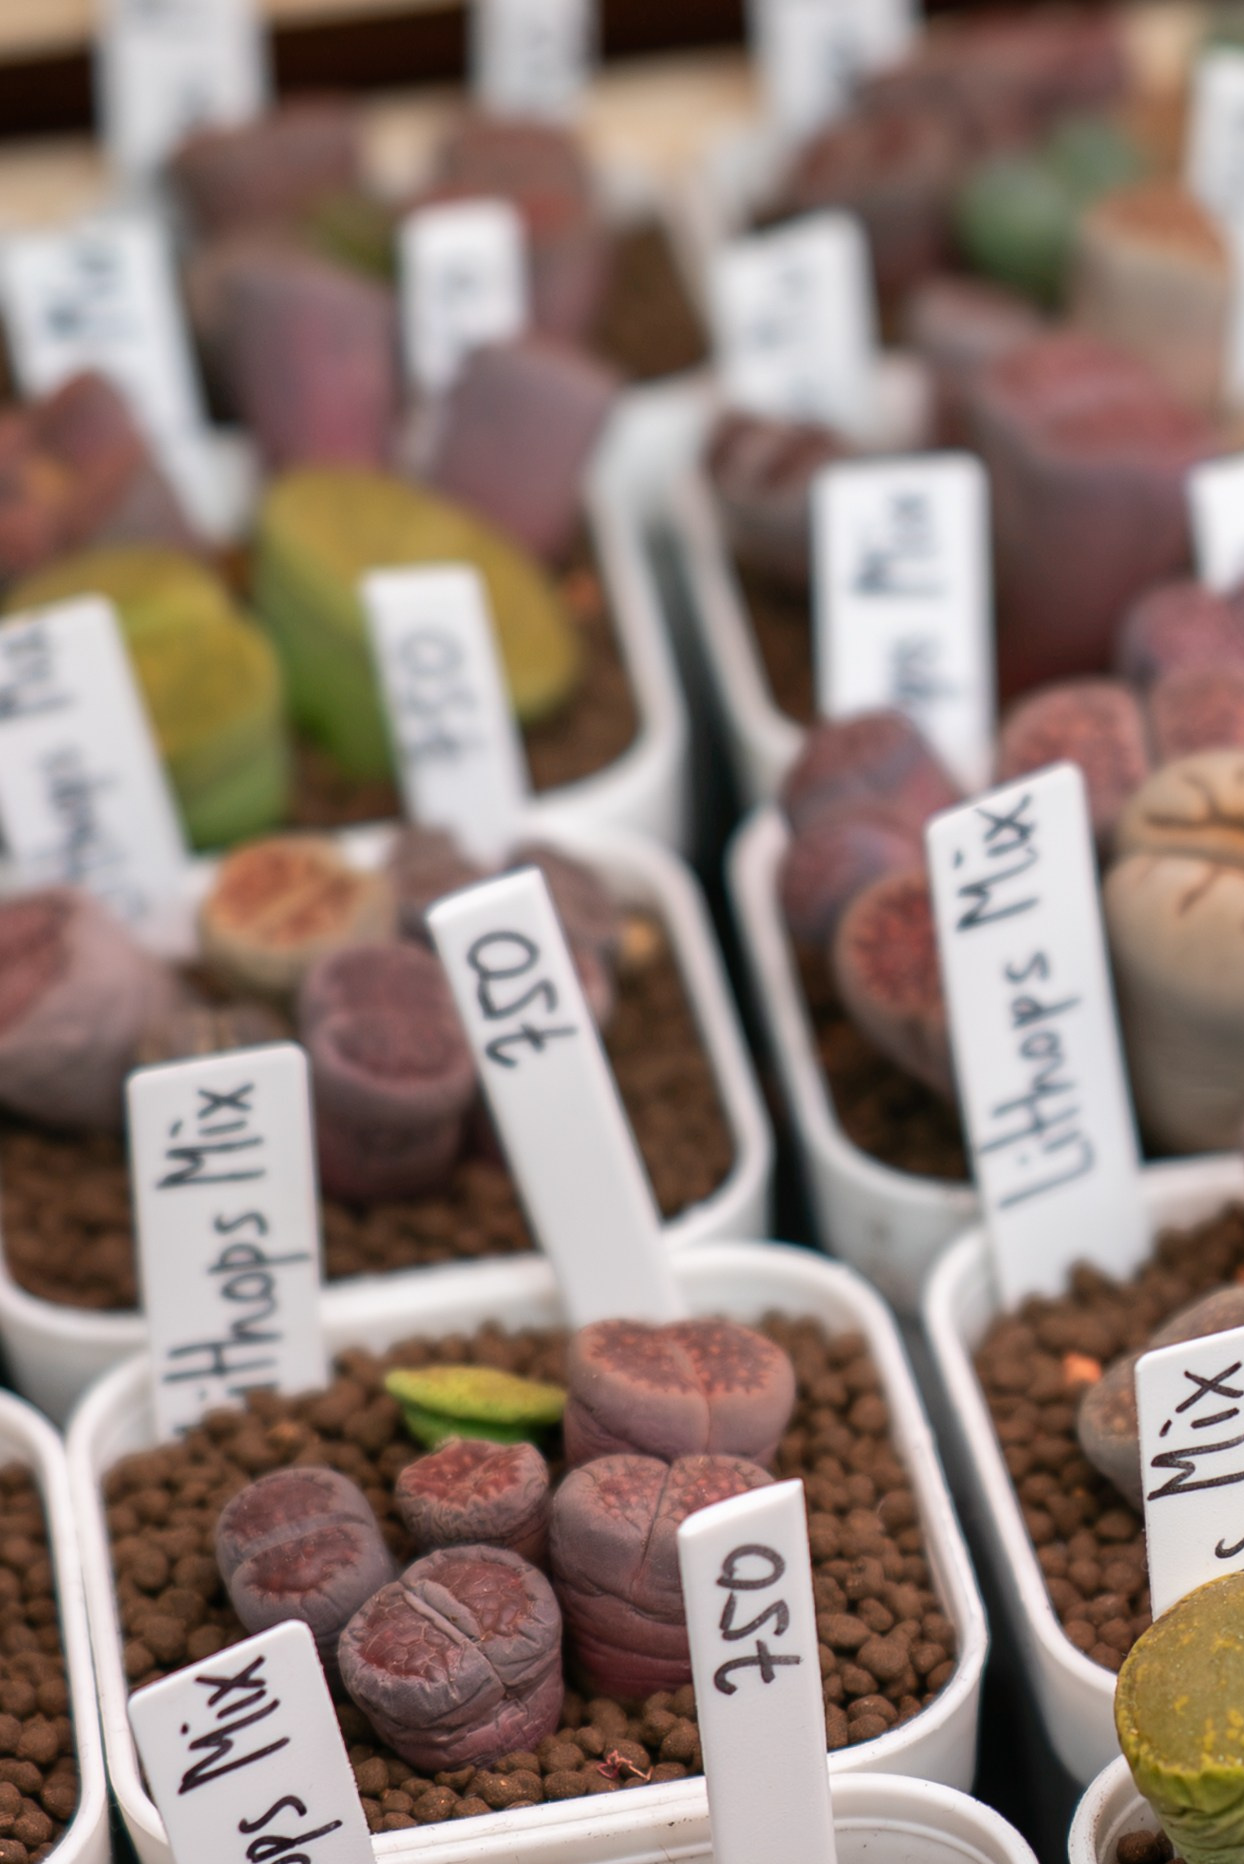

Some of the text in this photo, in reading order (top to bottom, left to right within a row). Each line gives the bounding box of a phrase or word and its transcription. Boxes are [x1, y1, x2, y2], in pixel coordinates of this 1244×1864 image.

[466, 929, 579, 1070] 750
[955, 794, 1098, 1210] Lithops Mix
[155, 1080, 314, 1434] ithops Mix
[712, 1543, 803, 1697] 750
[177, 1654, 290, 1797] Mix
